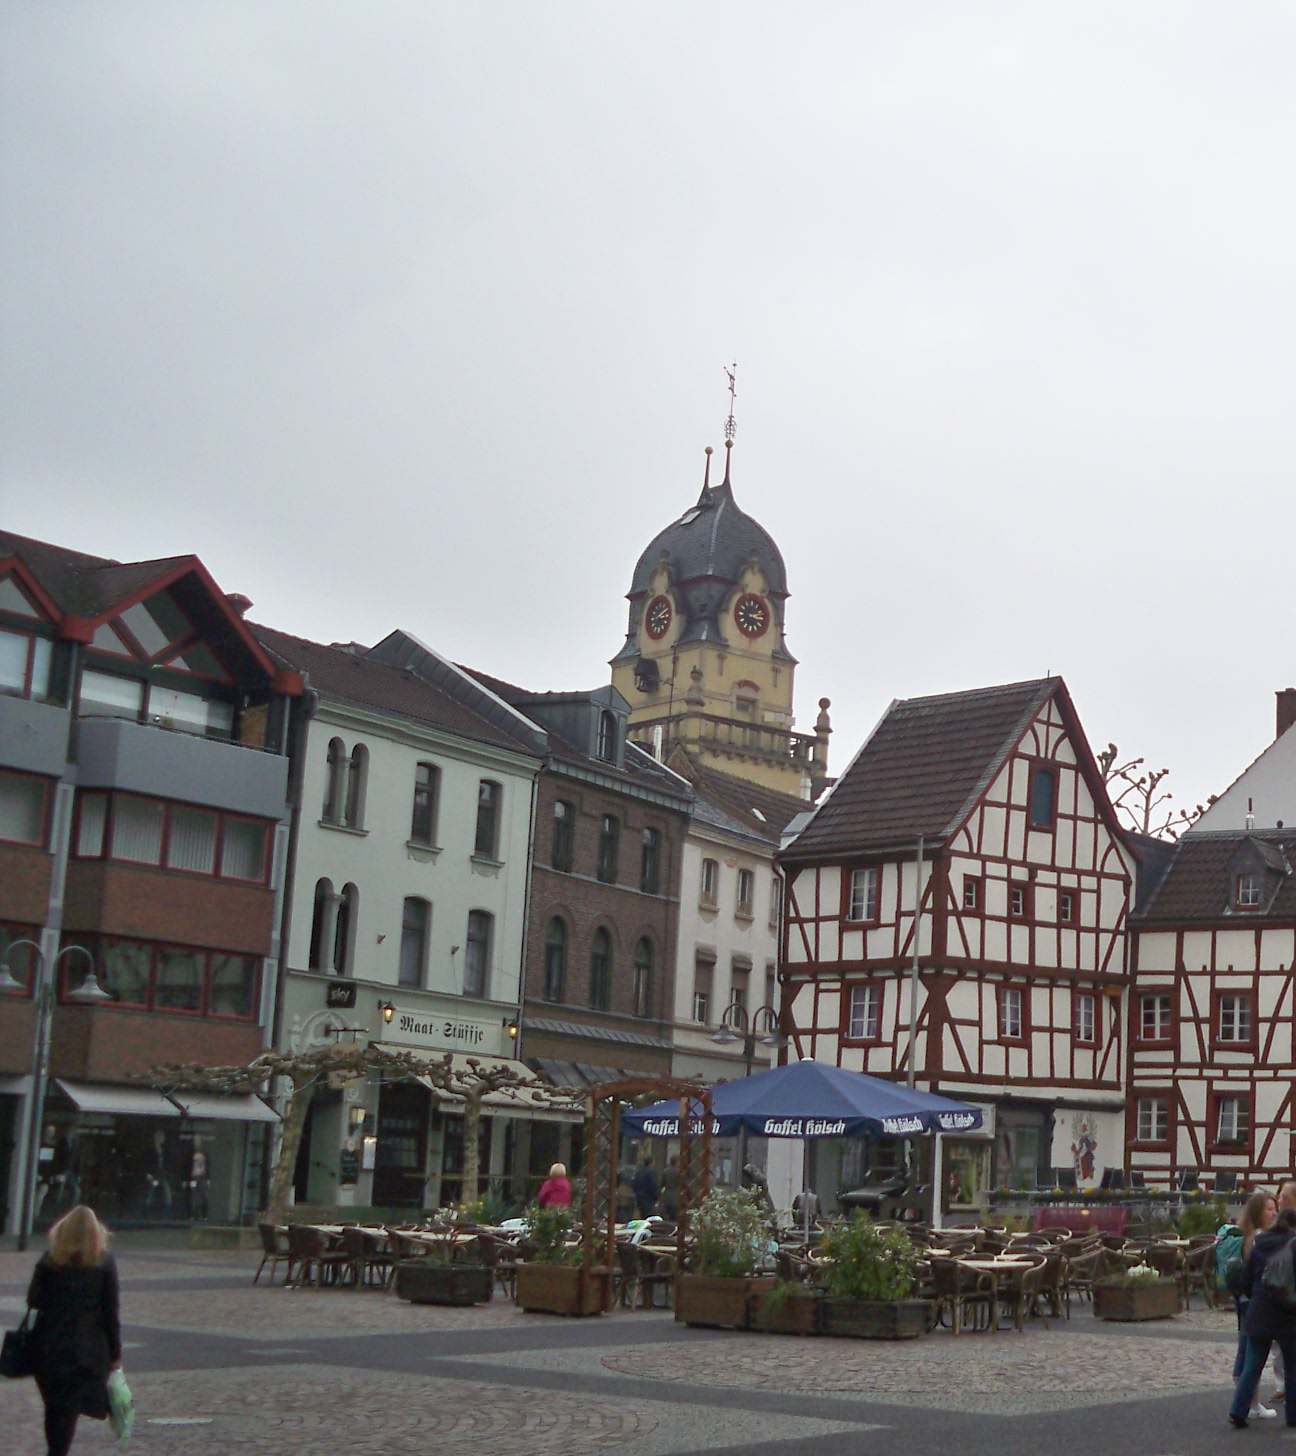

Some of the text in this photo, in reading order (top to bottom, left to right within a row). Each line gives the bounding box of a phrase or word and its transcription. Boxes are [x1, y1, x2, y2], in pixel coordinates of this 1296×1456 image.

[331, 987, 350, 1002] sky
[643, 1119, 679, 1136] Gaffel
[764, 1119, 846, 1135] Gaffel Kölsch
